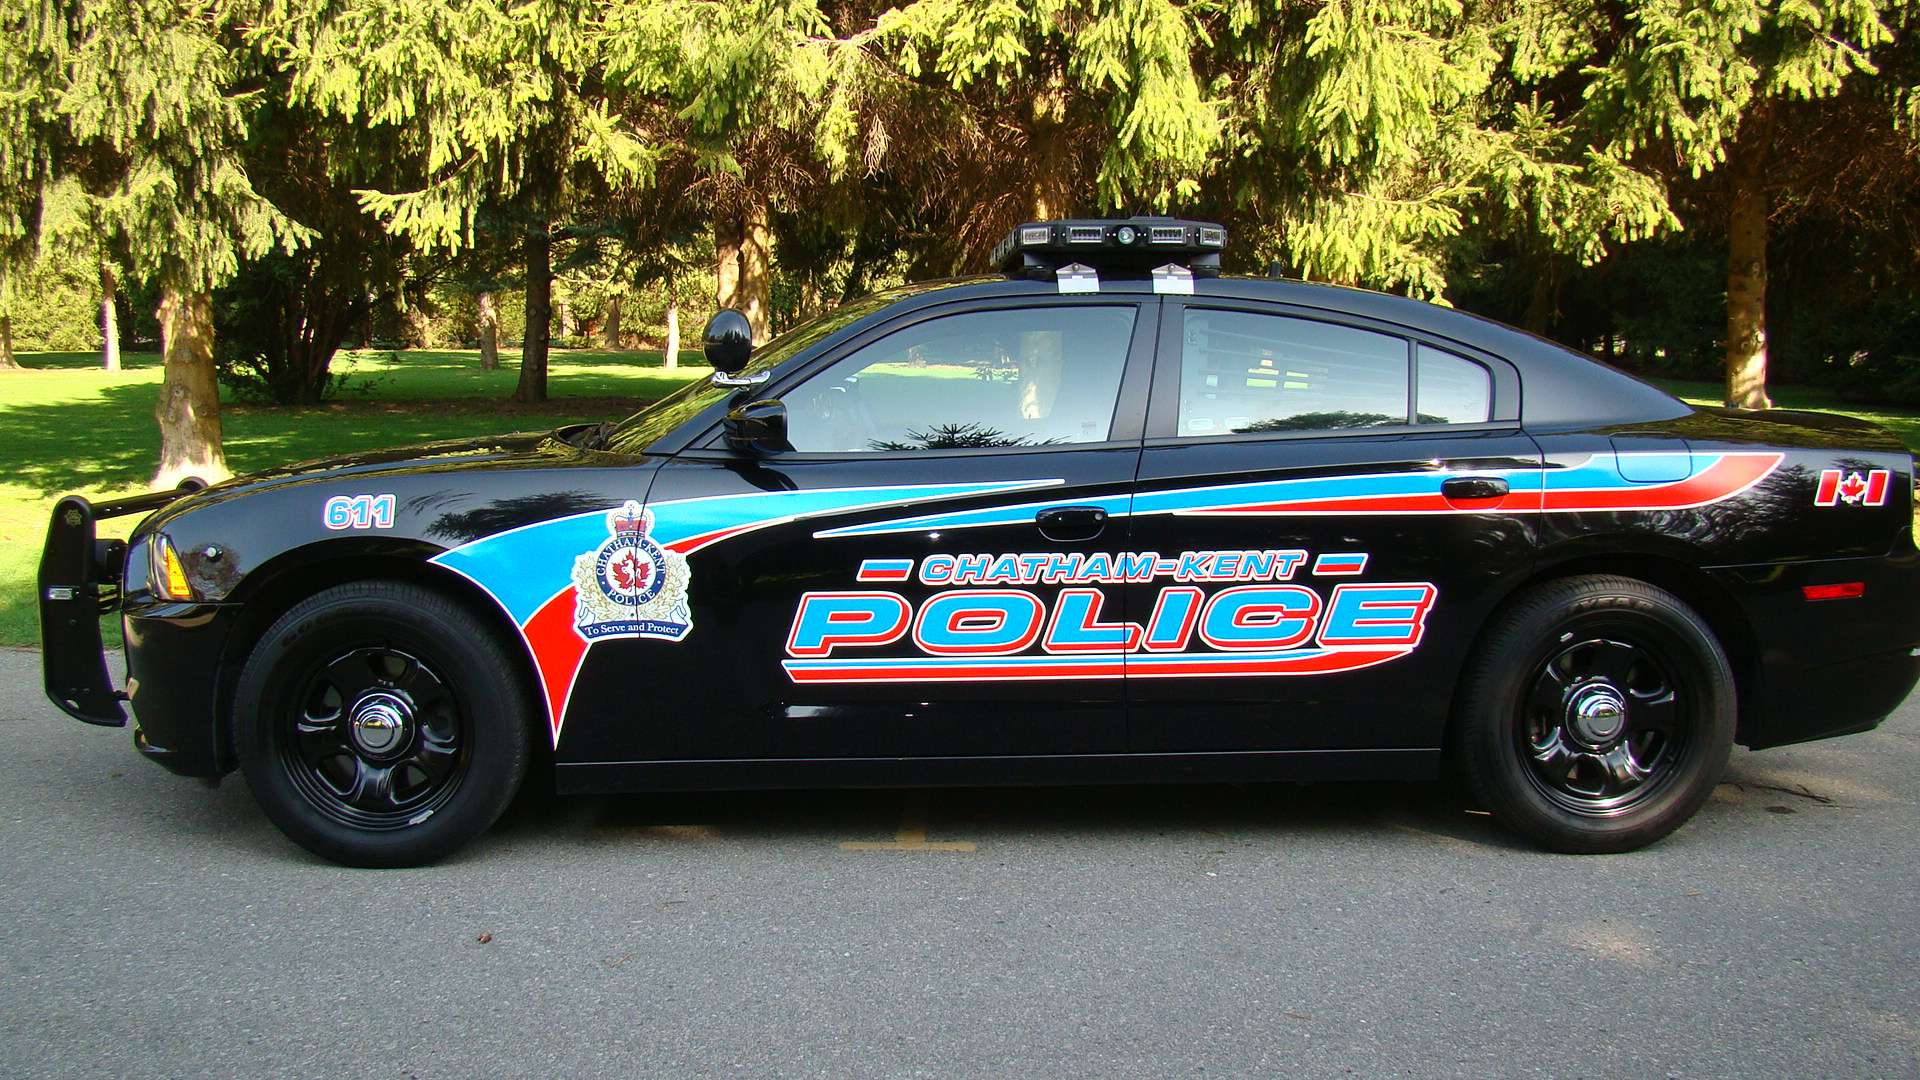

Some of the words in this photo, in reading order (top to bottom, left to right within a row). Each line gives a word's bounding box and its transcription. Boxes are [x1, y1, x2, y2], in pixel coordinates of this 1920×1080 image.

[324, 494, 396, 530] 611
[597, 538, 666, 576] CHATHAM-KENT
[919, 549, 1308, 585] CHATHAM-KENT
[607, 589, 656, 606] POLICE
[584, 626, 599, 636] To
[601, 624, 626, 633] Serve
[627, 622, 645, 632] and
[647, 622, 679, 635] Protect
[786, 582, 1437, 658] POLICE
